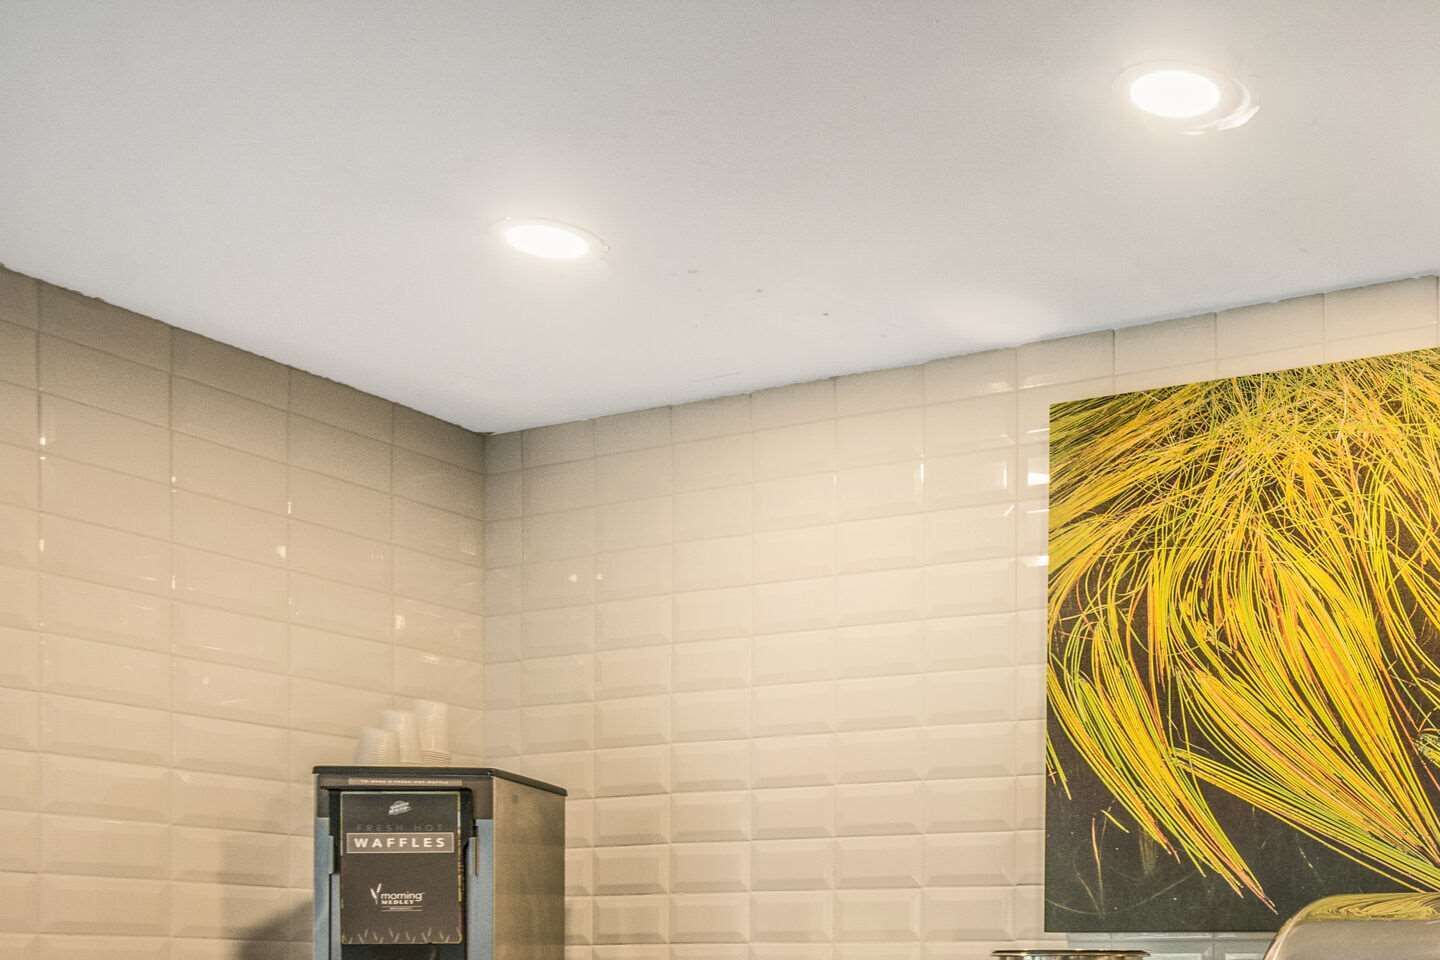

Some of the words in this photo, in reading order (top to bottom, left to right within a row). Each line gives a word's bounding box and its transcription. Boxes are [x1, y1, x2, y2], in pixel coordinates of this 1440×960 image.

[414, 823, 443, 832] HOT
[354, 837, 446, 848] WAFFLES
[380, 891, 424, 902] morning
